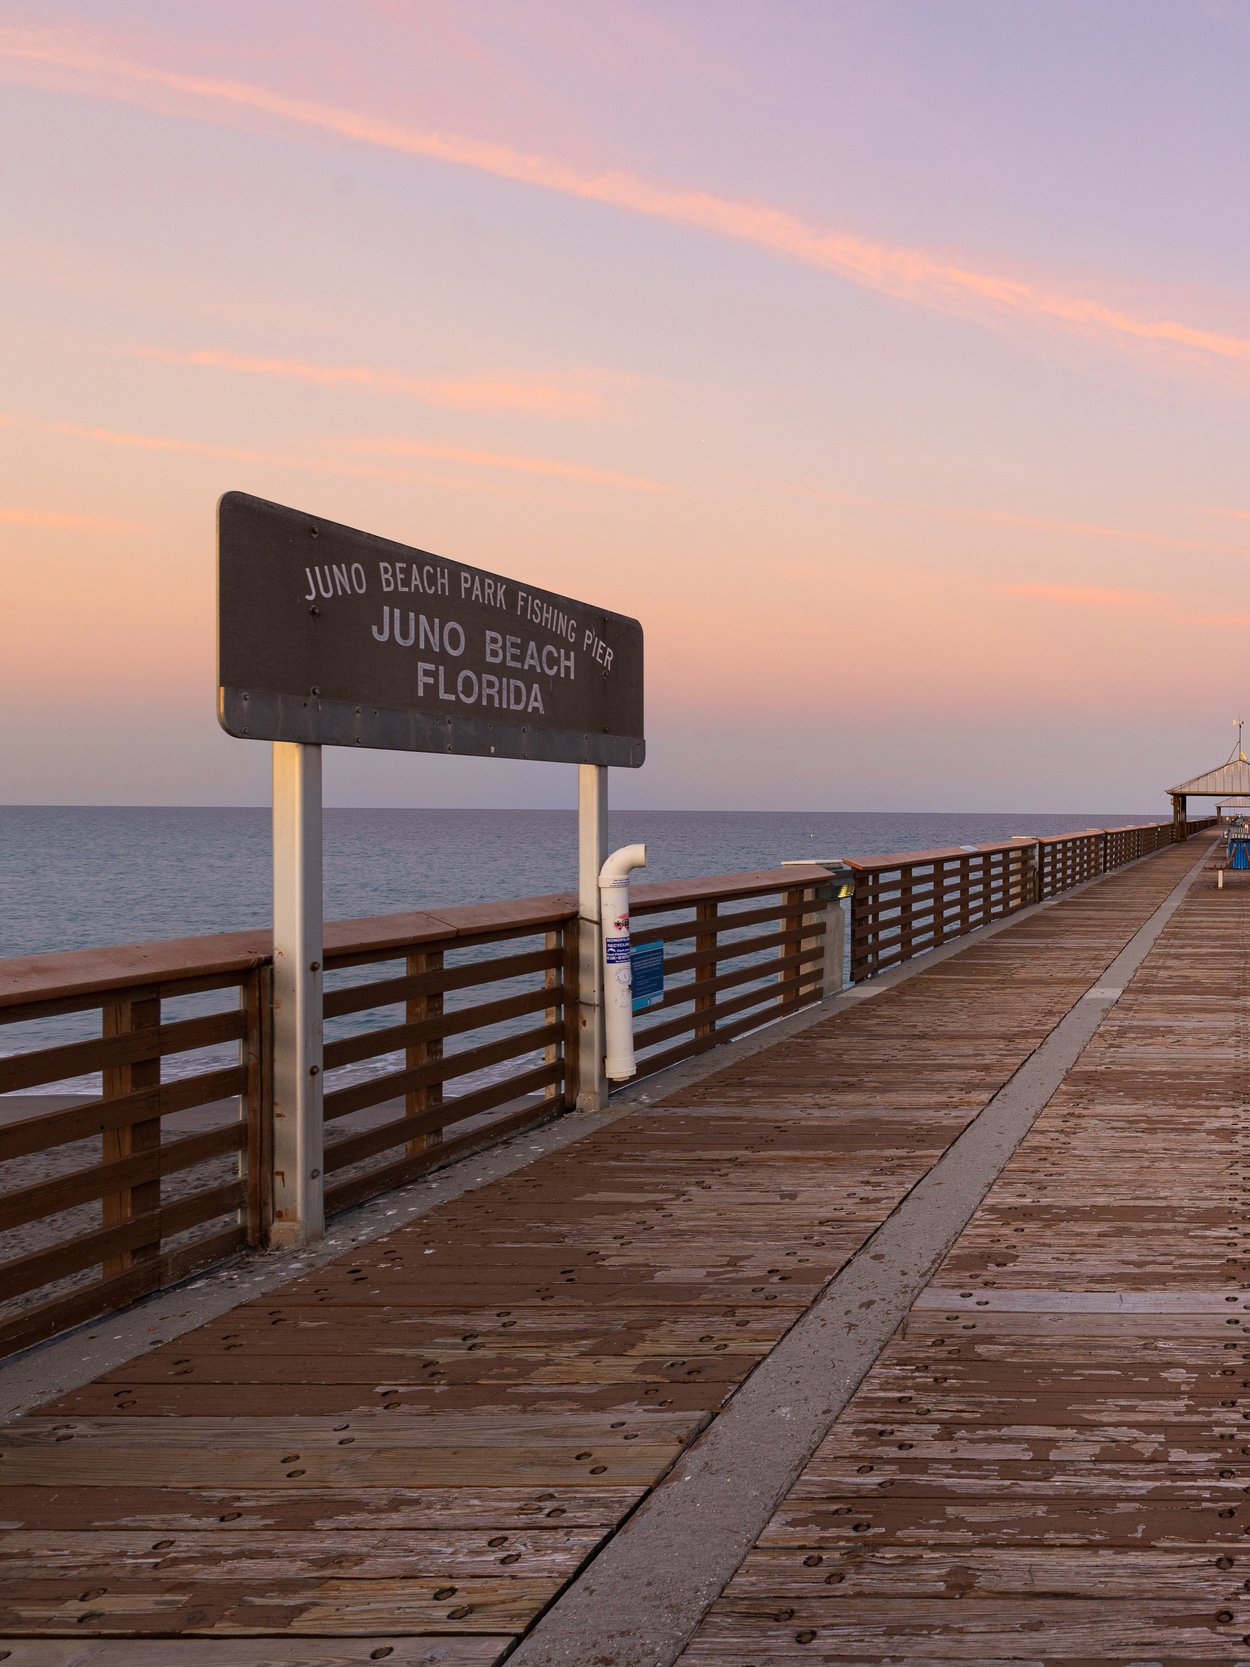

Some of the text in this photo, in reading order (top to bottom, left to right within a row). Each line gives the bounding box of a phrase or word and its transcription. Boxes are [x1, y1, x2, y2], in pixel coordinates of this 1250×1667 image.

[304, 561, 614, 671] JUNO BEACH PARK FISHING PIER
[371, 606, 576, 680] JUNO BEACH
[417, 661, 545, 715] FLORIDA
